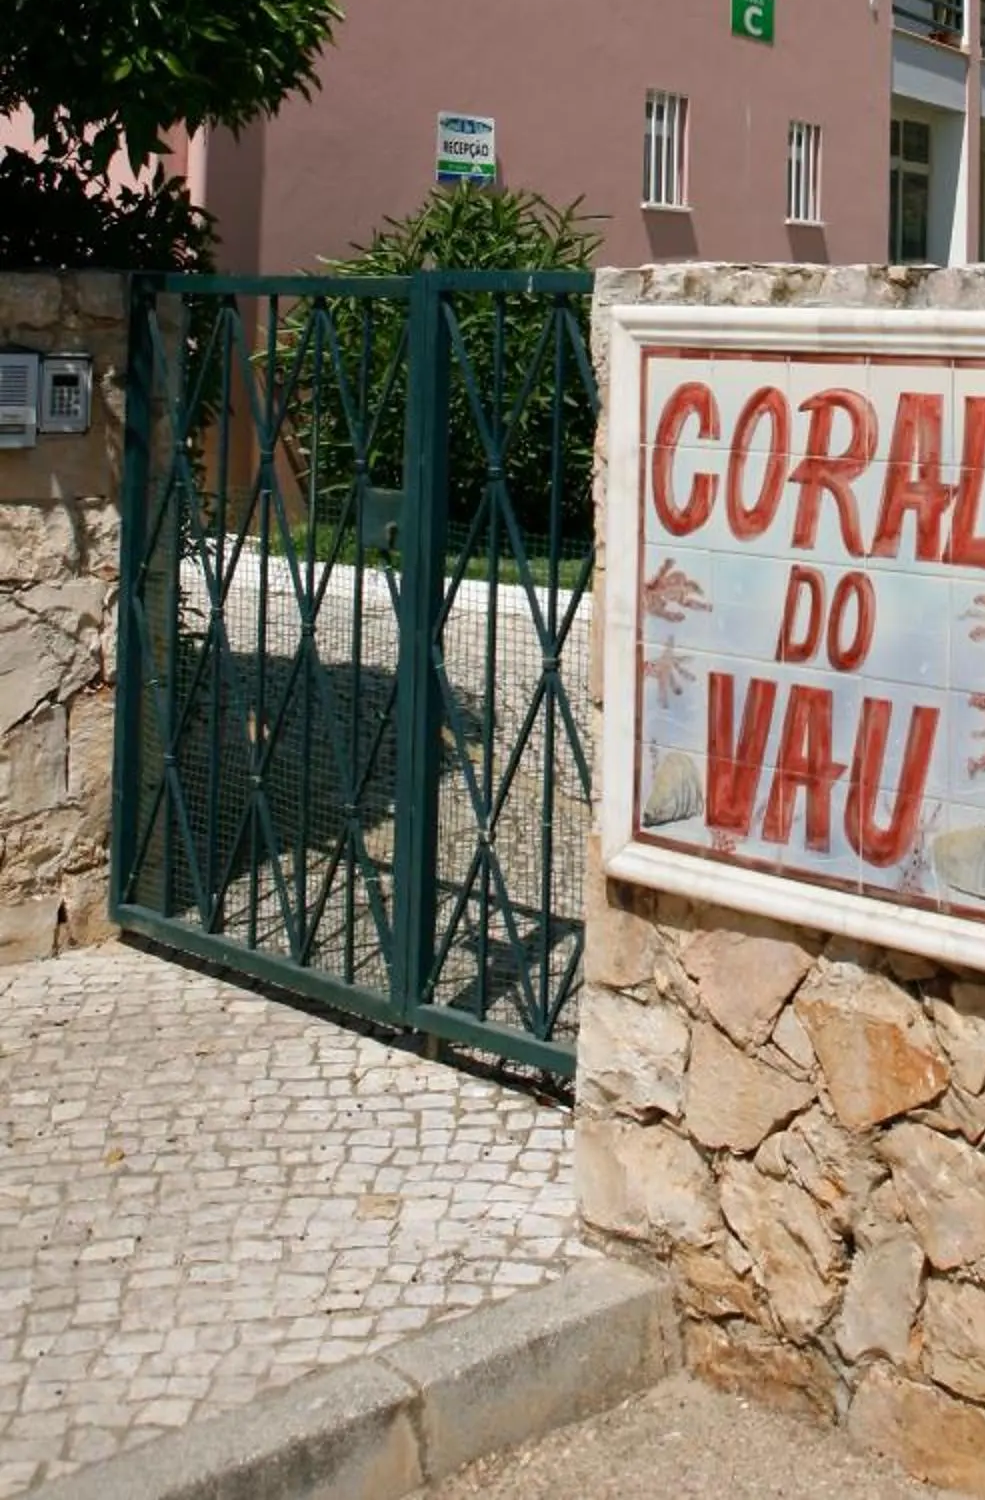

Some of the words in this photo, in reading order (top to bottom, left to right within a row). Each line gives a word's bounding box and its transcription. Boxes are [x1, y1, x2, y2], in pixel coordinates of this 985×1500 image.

[744, 6, 763, 36] C
[443, 140, 489, 158] RECEPÇÃO
[775, 564, 875, 670] DO
[706, 672, 939, 867] VAU
